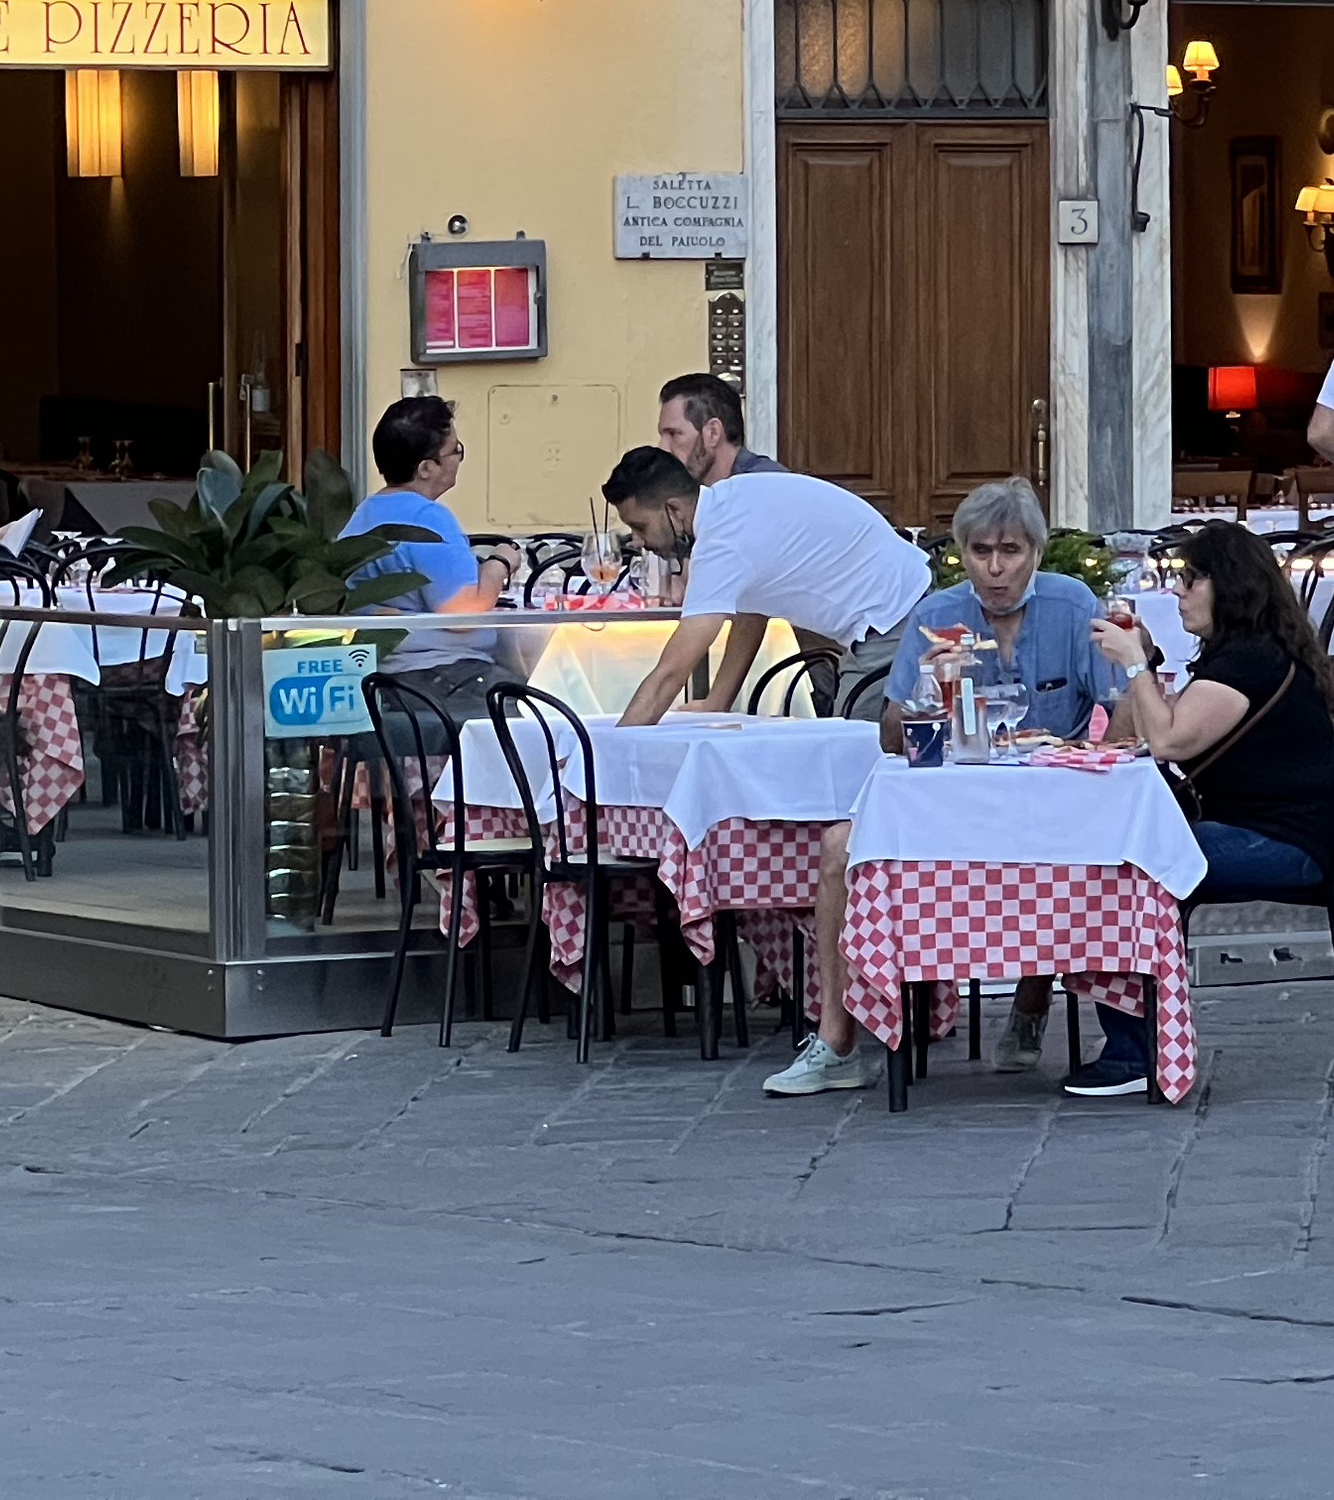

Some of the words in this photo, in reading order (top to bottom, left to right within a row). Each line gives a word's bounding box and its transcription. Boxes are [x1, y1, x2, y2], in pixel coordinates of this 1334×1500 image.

[42, 0, 312, 56] PIZZERIA
[652, 180, 712, 191] SALETTA
[652, 196, 738, 210] BOCCUZZI
[623, 216, 669, 227] ANTICA
[673, 216, 745, 228] COMPAGNIA
[1070, 208, 1088, 236] 3
[639, 236, 663, 247] DEL
[671, 236, 726, 247] PAIUOLO
[297, 659, 344, 674] FREE
